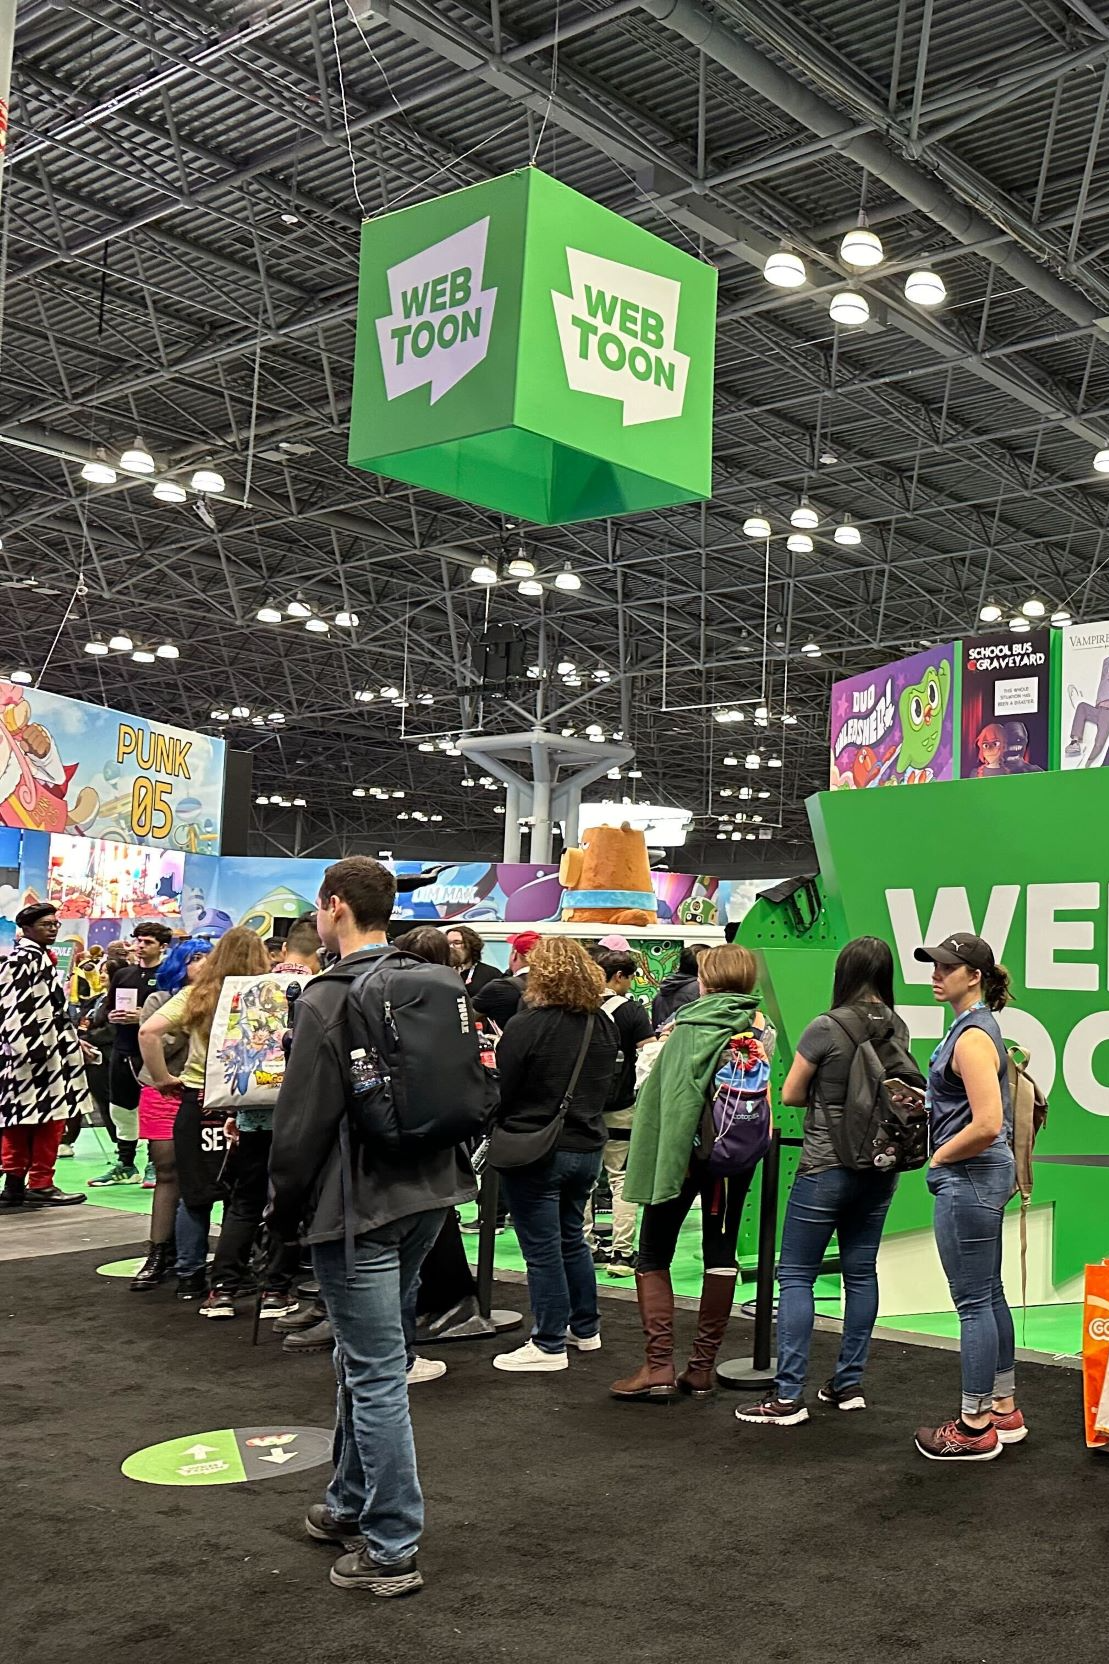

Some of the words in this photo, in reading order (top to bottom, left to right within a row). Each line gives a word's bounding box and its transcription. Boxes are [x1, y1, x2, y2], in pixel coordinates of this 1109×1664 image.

[401, 266, 472, 319] WEB
[584, 284, 664, 349] WEB
[391, 307, 482, 366] TOON
[572, 314, 675, 391] TOON
[968, 645, 1011, 660] SCHOOL
[1012, 642, 1033, 655] BUS
[976, 653, 1045, 671] GRAVEYARD
[853, 684, 875, 713] DUO
[117, 724, 192, 779] PUNK
[131, 776, 173, 838] 05
[457, 996, 470, 1034] THULE
